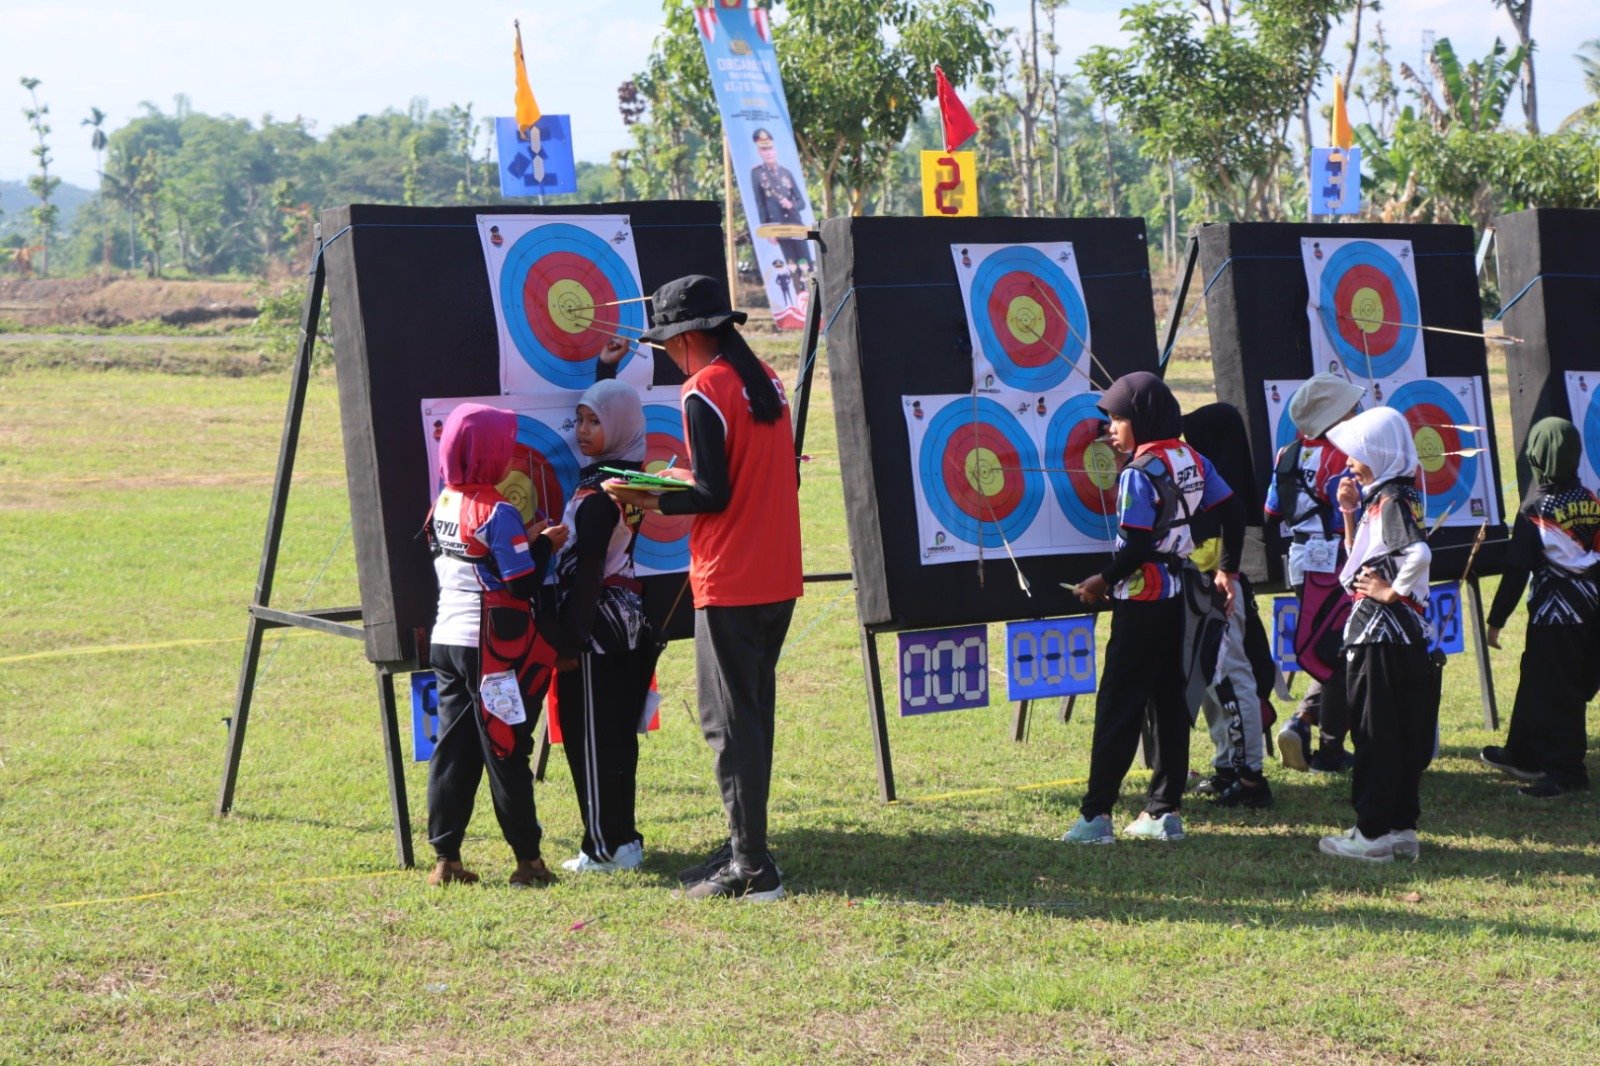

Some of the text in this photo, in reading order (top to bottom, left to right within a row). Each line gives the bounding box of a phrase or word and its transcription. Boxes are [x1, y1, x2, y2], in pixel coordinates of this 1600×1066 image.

[934, 157, 961, 215] 2
[1326, 152, 1348, 209] 3
[903, 636, 986, 707] 000
[1012, 627, 1093, 687] 000
